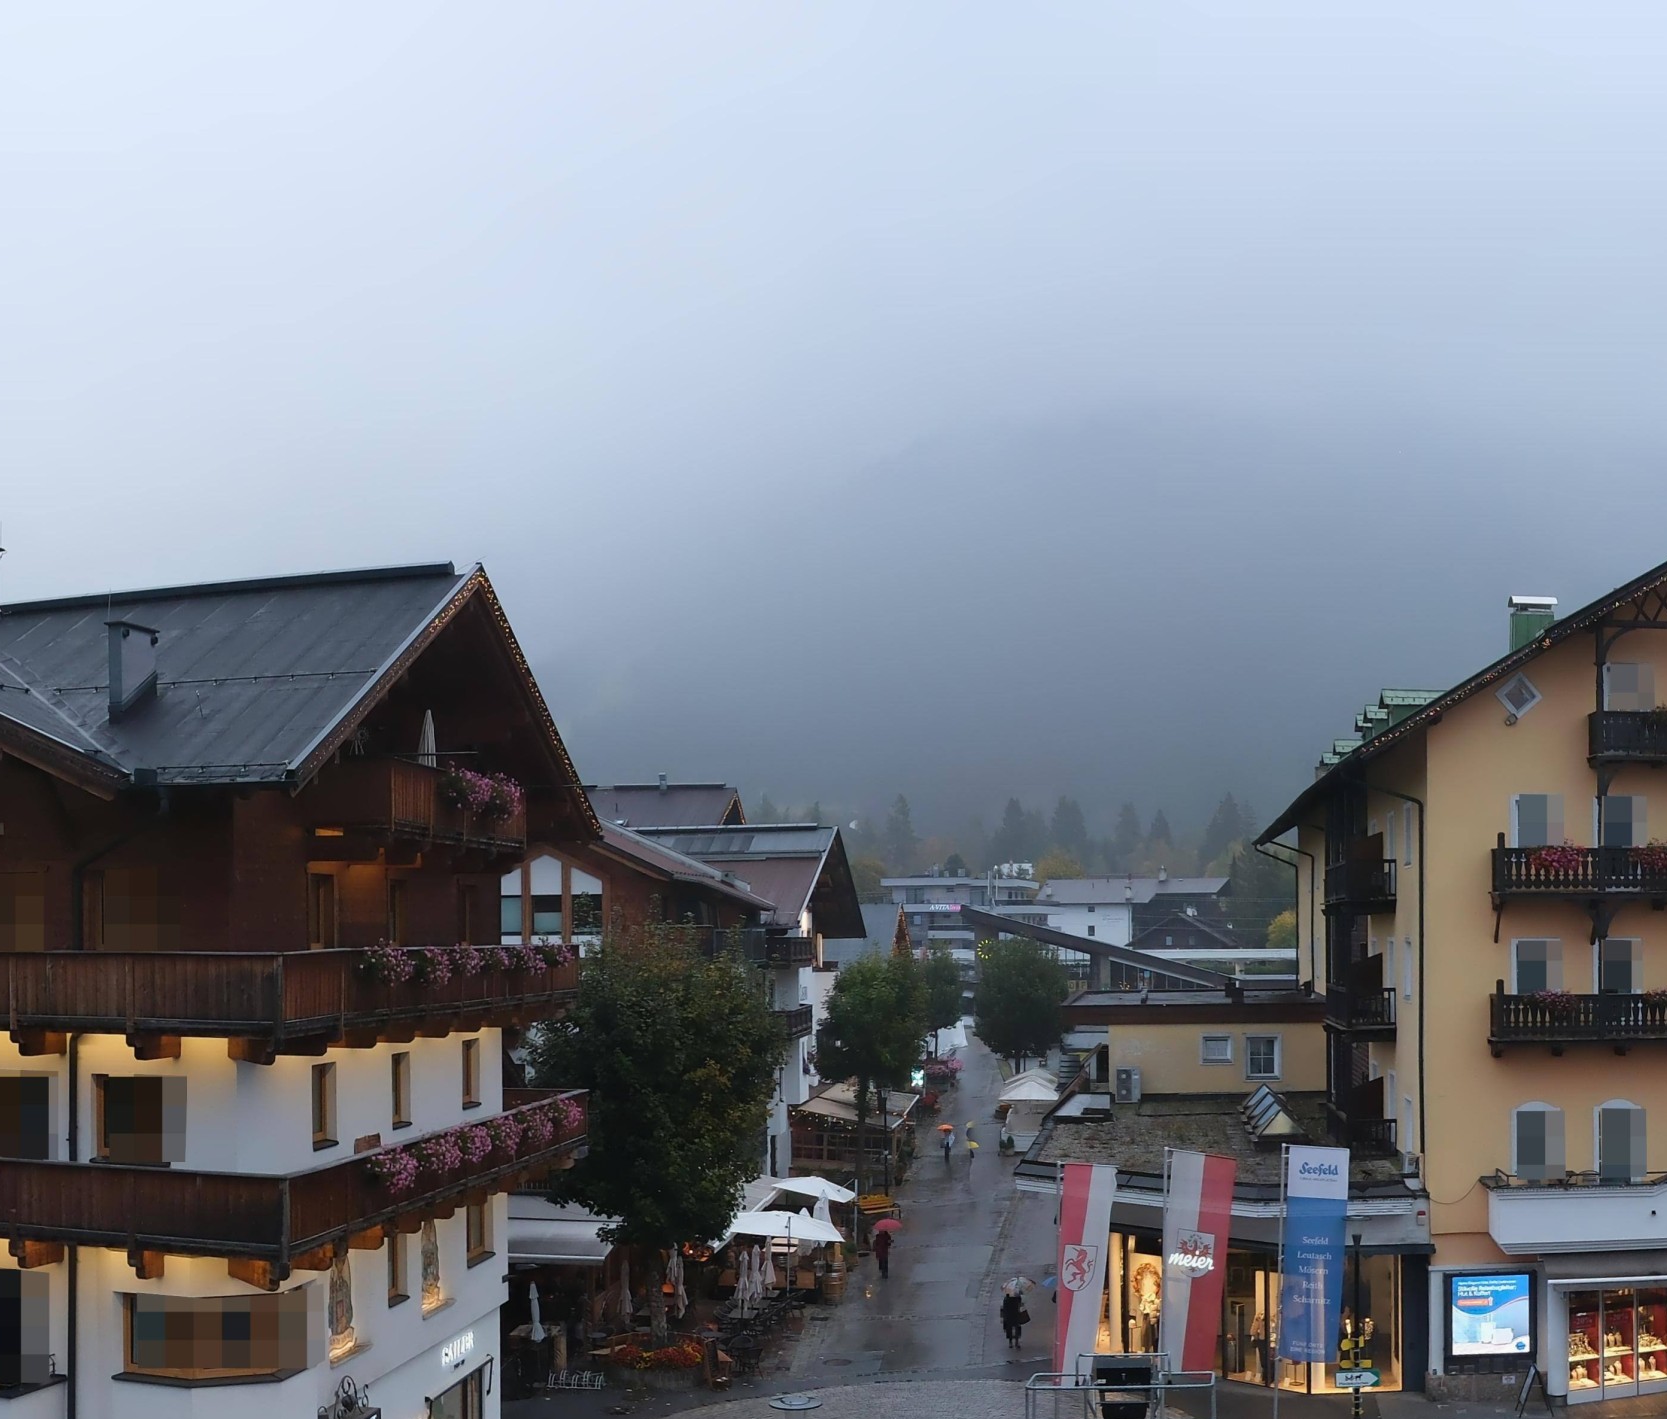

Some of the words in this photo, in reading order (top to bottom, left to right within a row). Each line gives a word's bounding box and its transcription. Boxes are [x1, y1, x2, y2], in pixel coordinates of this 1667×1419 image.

[1299, 1161, 1339, 1177] Seefeld
[1302, 1236, 1329, 1246] Seefeld
[1168, 1250, 1215, 1271] meier
[1297, 1251, 1332, 1261] Leutasch
[1299, 1265, 1329, 1275] Mösern
[1302, 1280, 1324, 1290] Reith
[1293, 1294, 1331, 1305] Scharnitz
